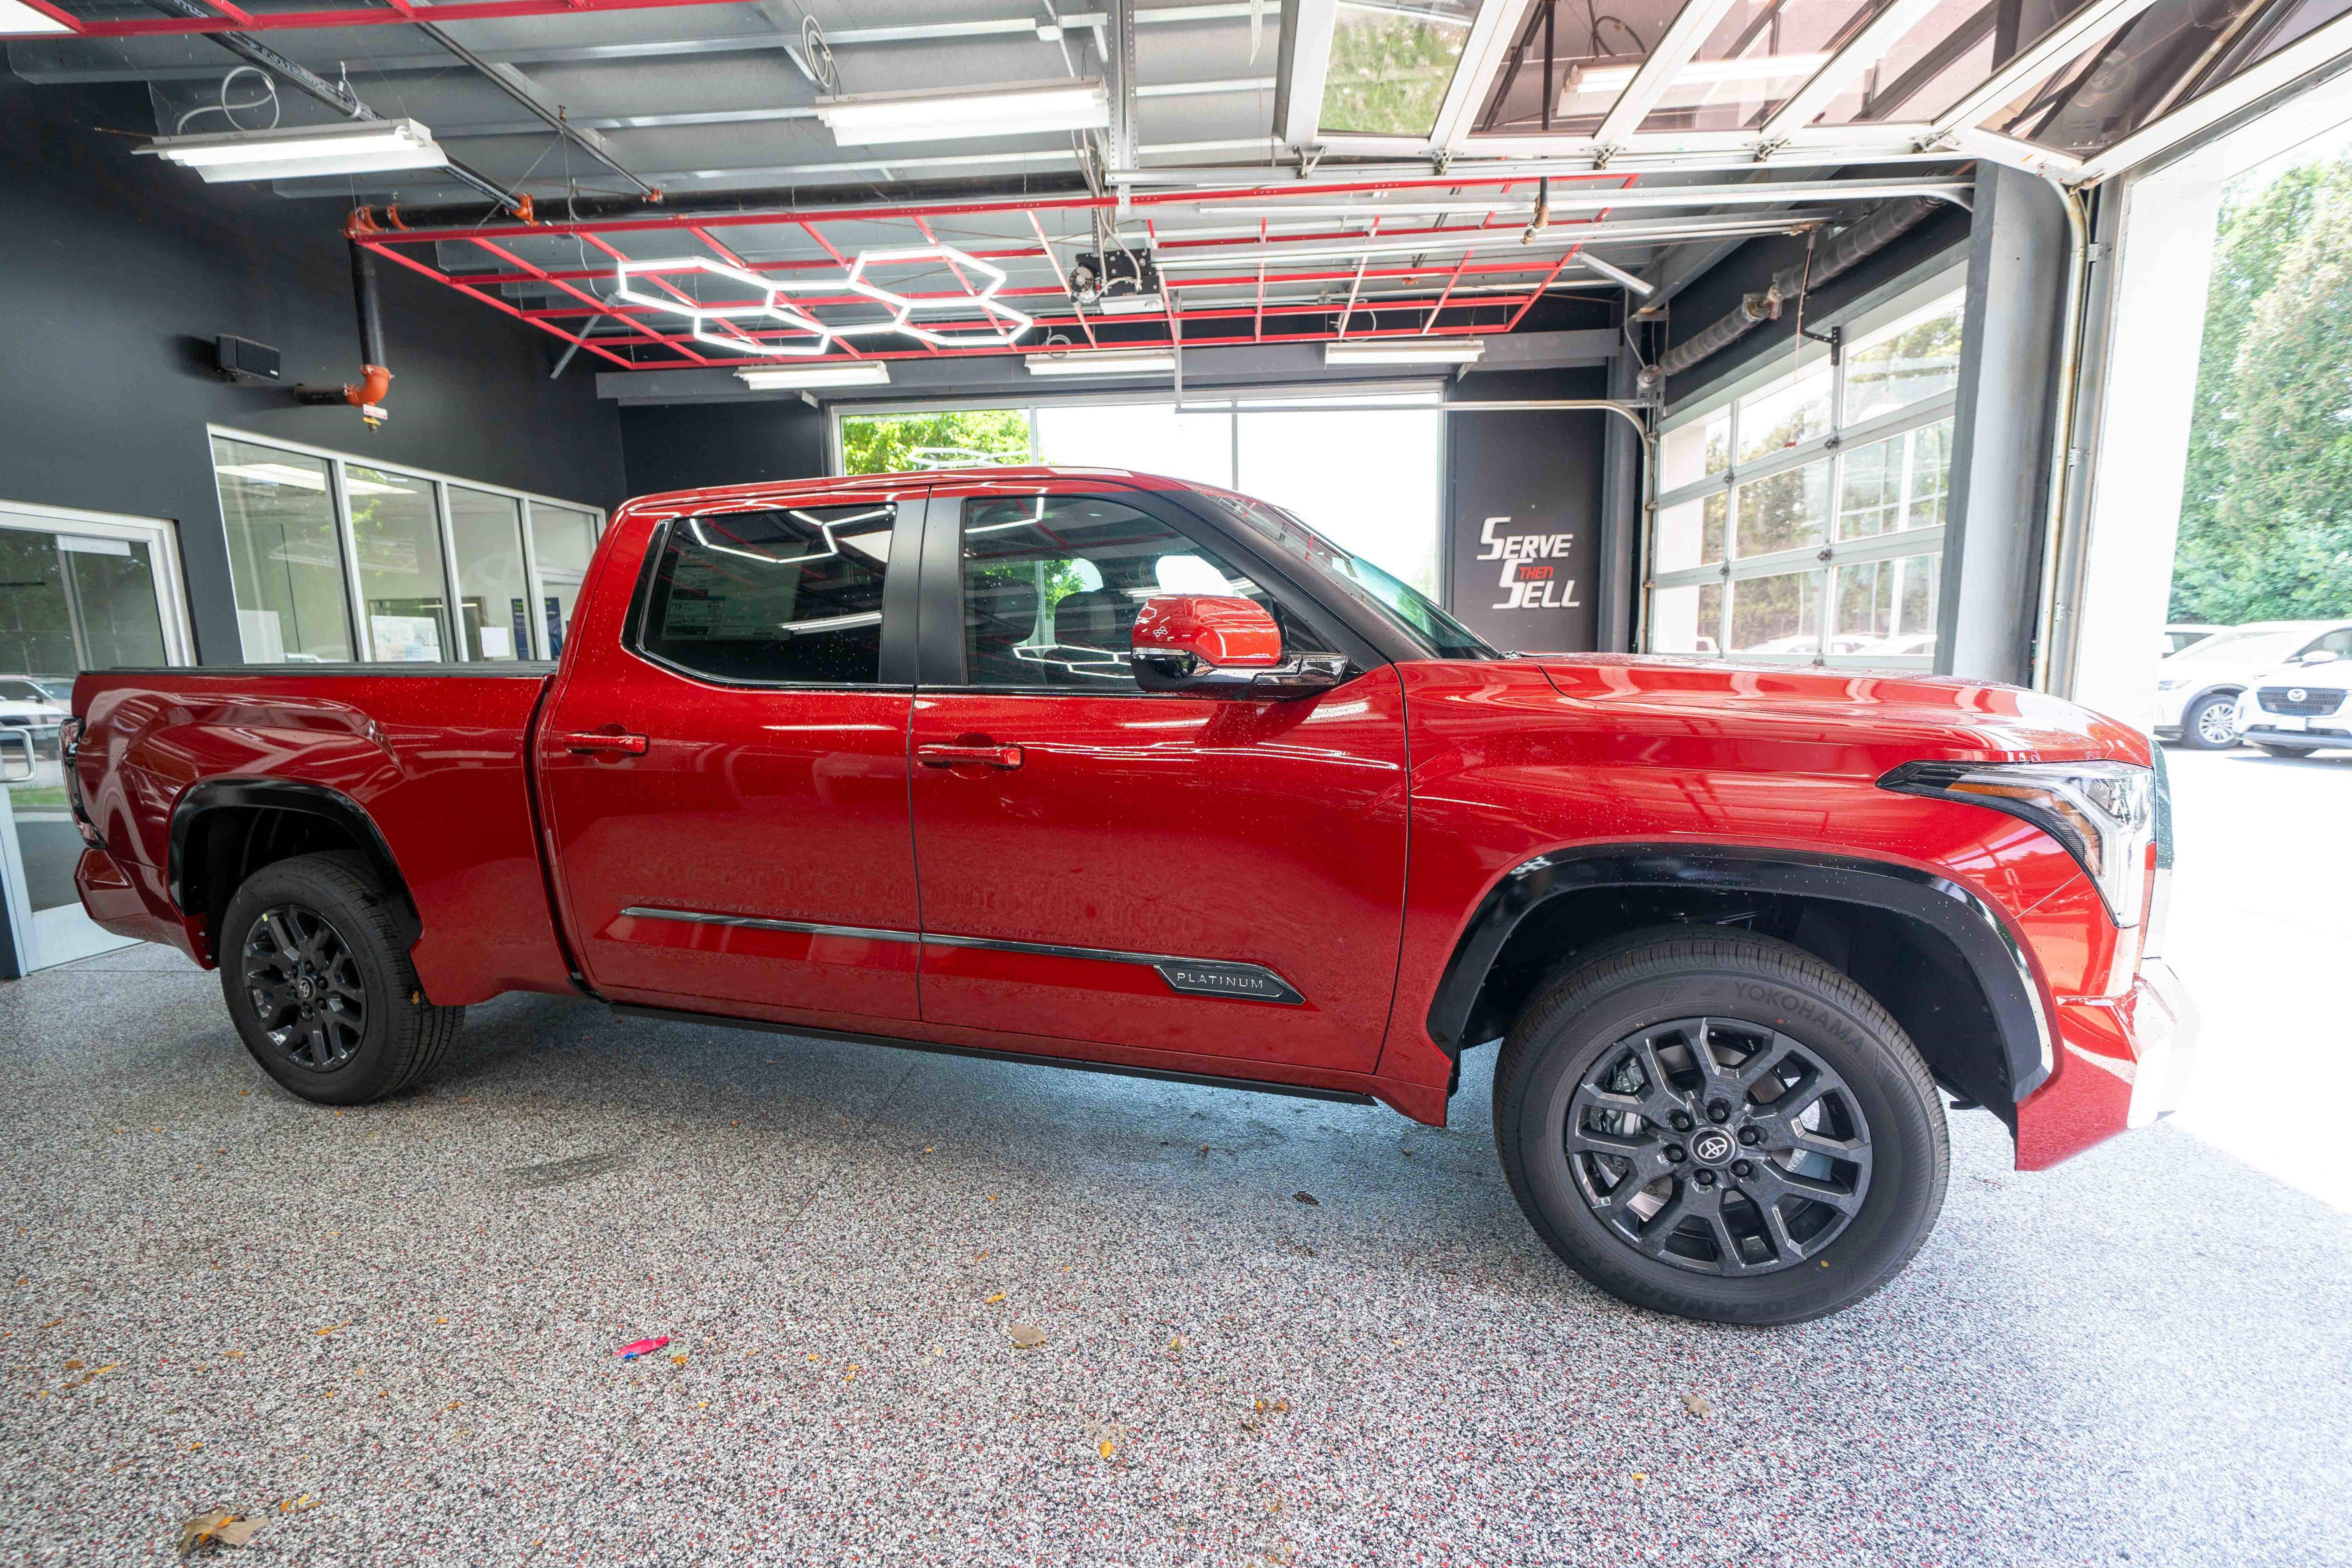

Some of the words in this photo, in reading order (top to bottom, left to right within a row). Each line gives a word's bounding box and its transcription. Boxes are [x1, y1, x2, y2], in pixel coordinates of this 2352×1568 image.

[1477, 517, 1573, 560] SERVE
[1492, 558, 1580, 609] SELL
[1519, 566, 1554, 580] THEN
[1177, 973, 1263, 988] PLATINUM
[1735, 982, 1864, 1053] YOKOHAMA
